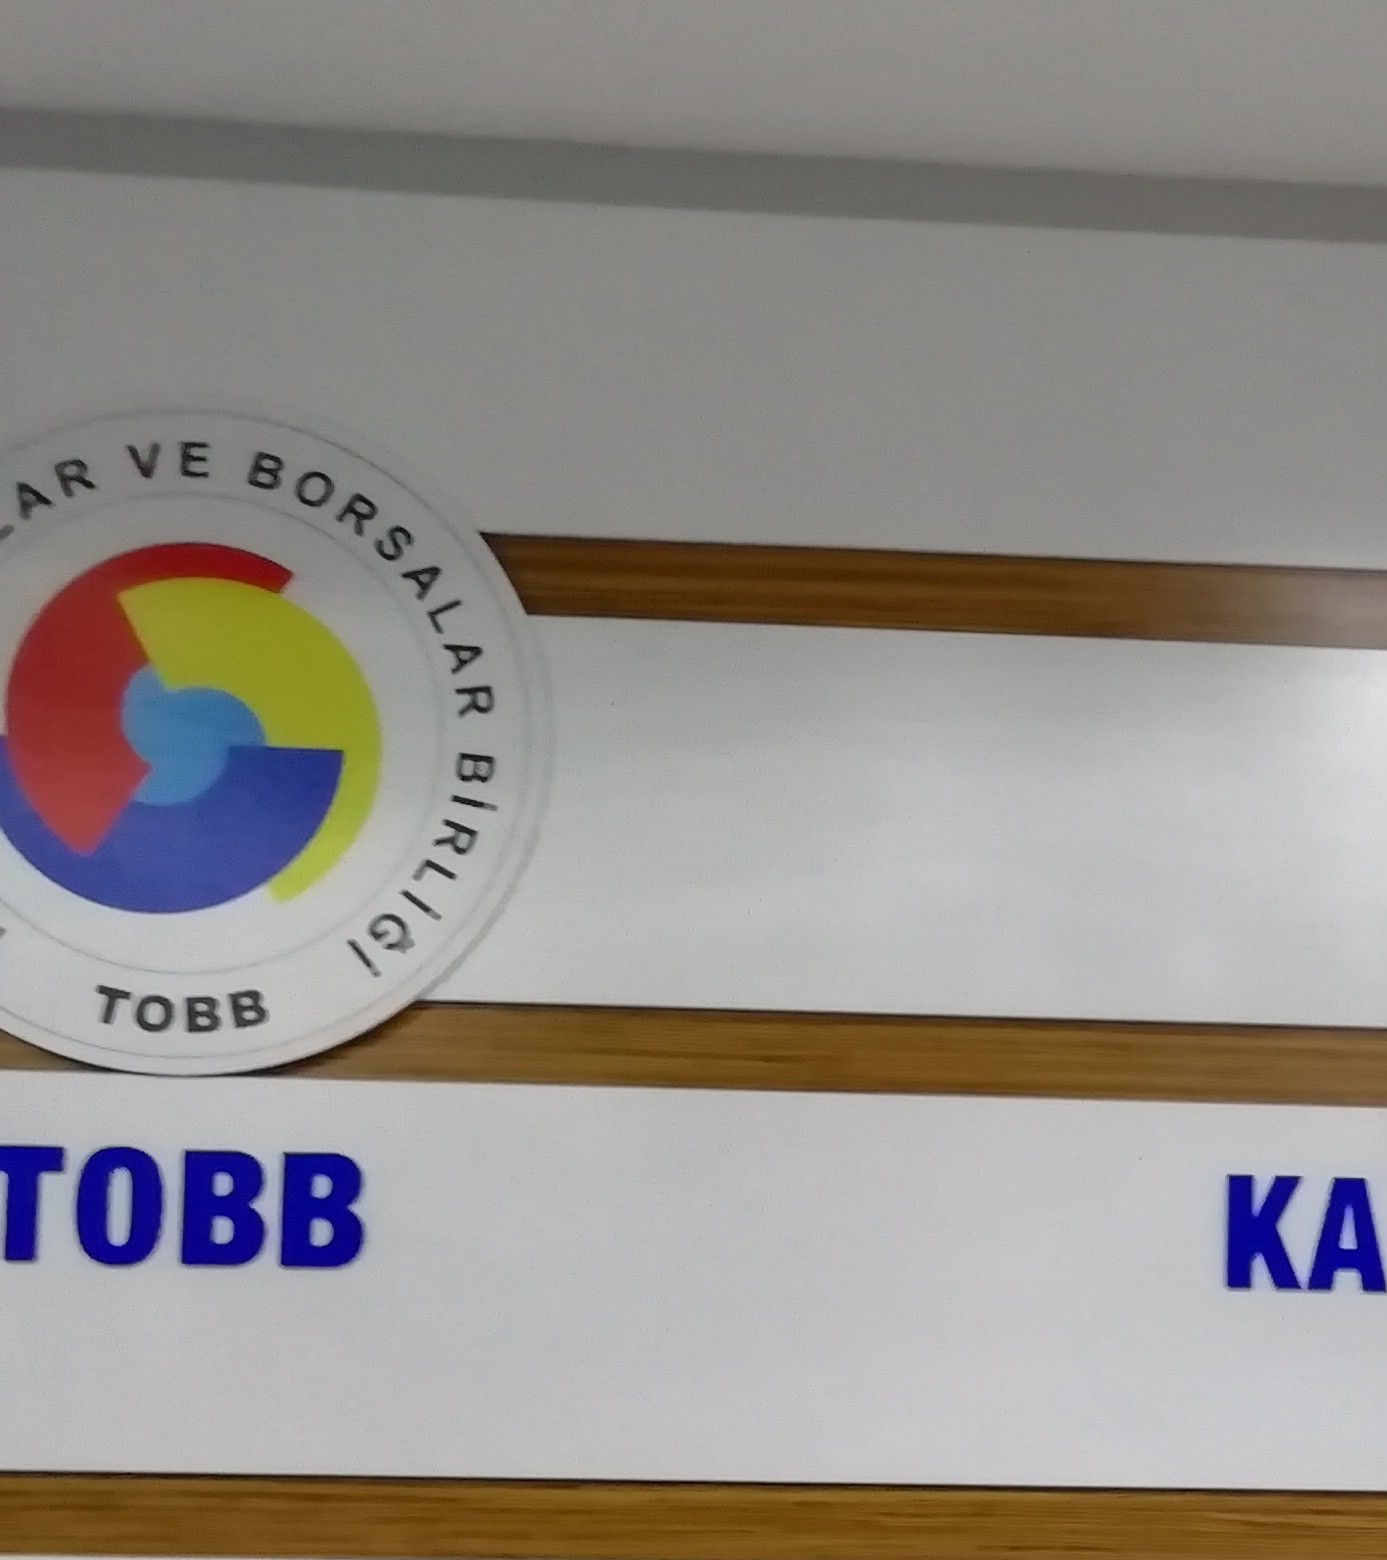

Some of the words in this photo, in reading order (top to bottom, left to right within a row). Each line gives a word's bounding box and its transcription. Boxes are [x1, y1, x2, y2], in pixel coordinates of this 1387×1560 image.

[124, 439, 211, 480] VE
[248, 452, 494, 720] BORSALAR
[95, 983, 270, 1033] TOBB
[0, 1144, 366, 1268] TOBB
